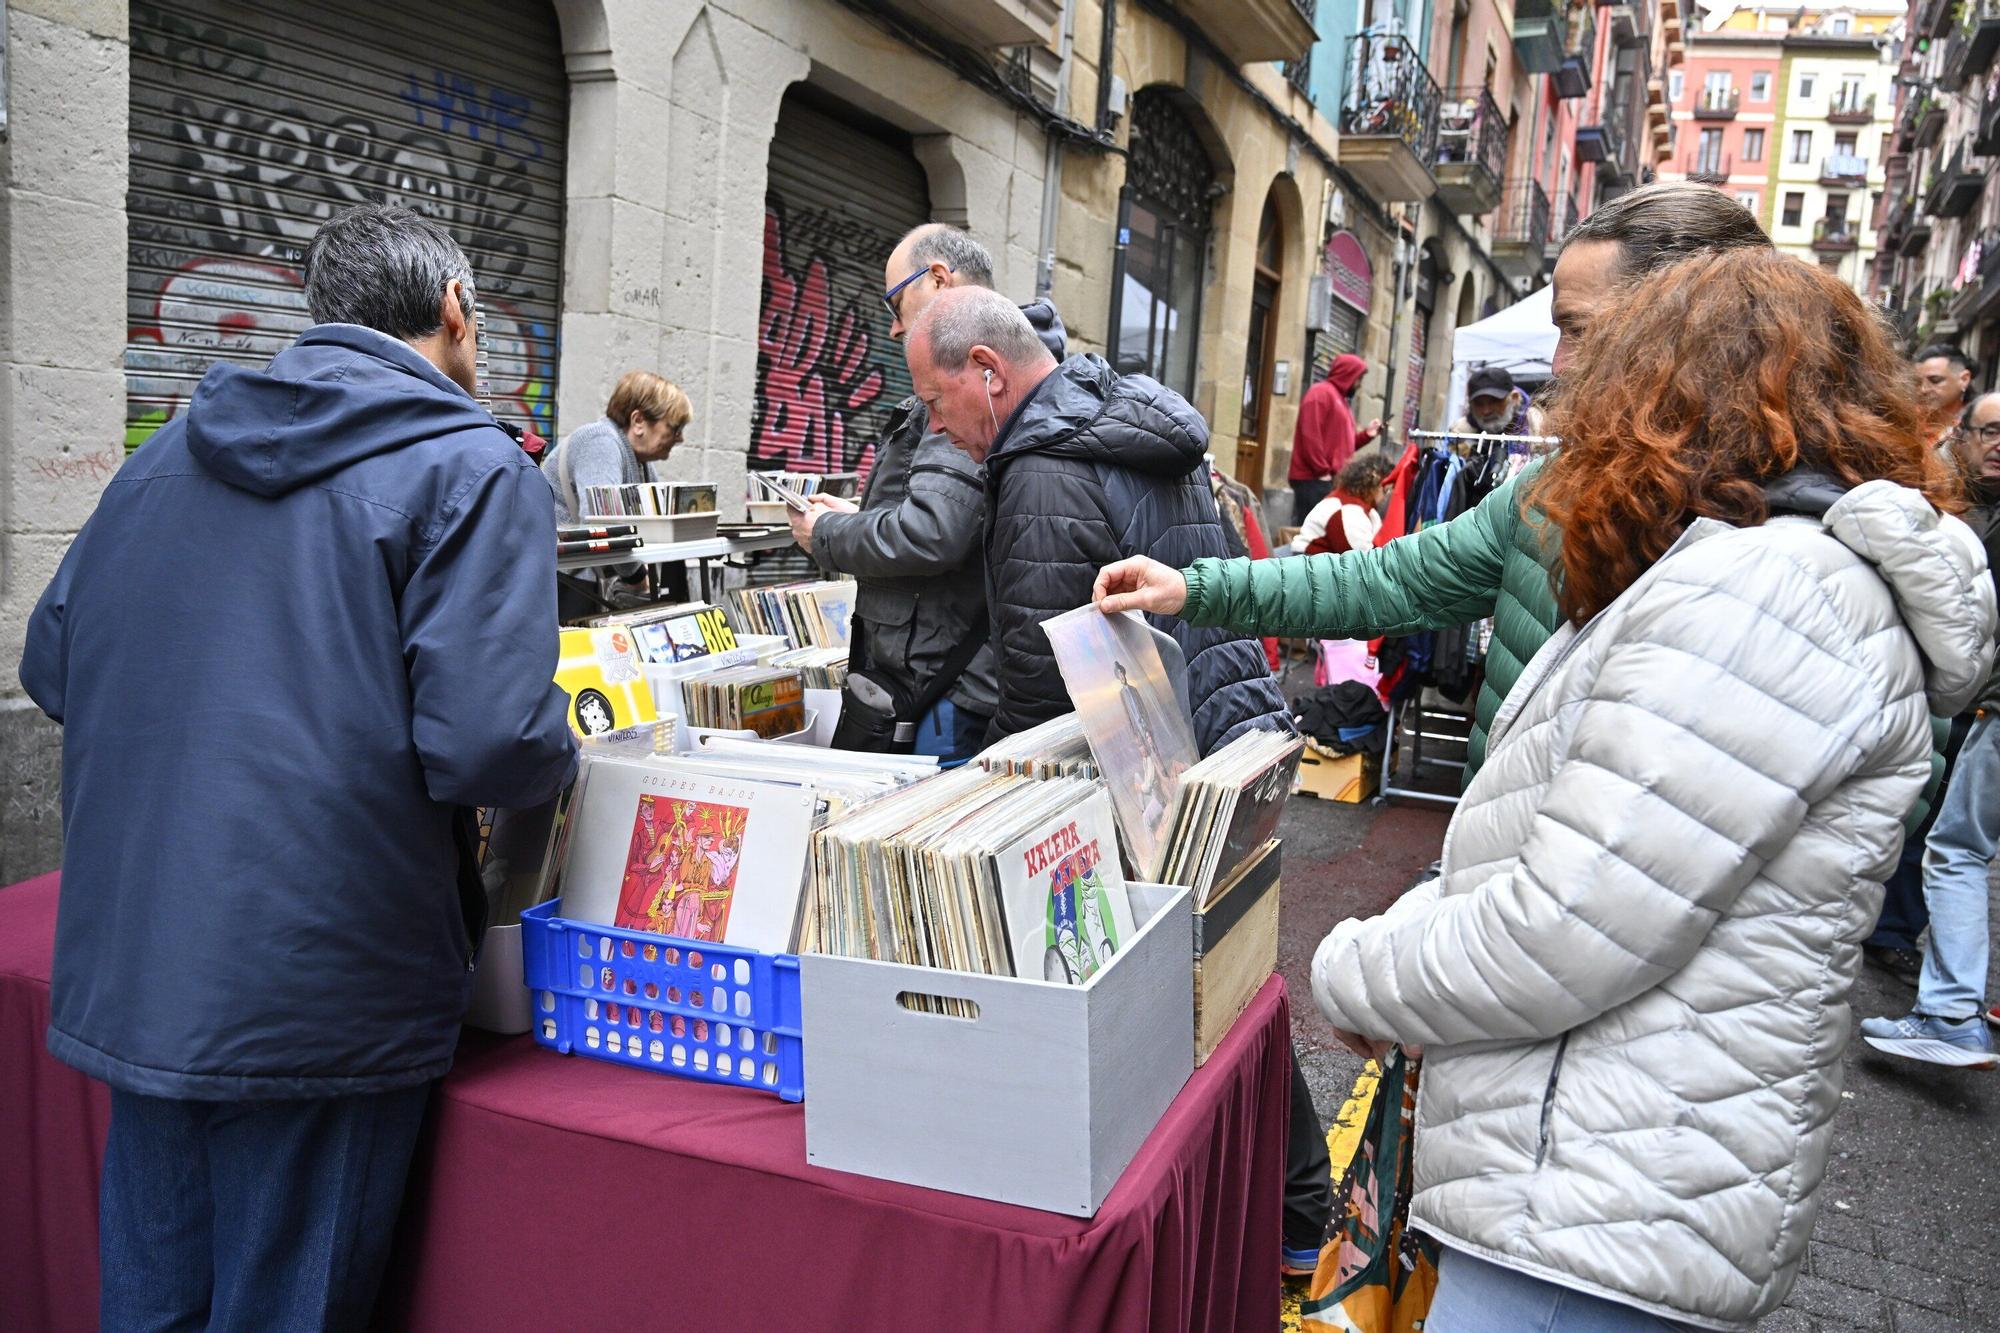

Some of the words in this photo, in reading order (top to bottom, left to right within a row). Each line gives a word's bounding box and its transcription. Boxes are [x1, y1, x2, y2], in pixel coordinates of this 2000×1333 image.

[624, 287, 661, 308] OMAR
[696, 608, 739, 655] BIG
[608, 729, 640, 744] VINILOS
[643, 775, 697, 792] GOLPES
[708, 784, 755, 800] BAJOS
[1024, 821, 1081, 879] KALERA
